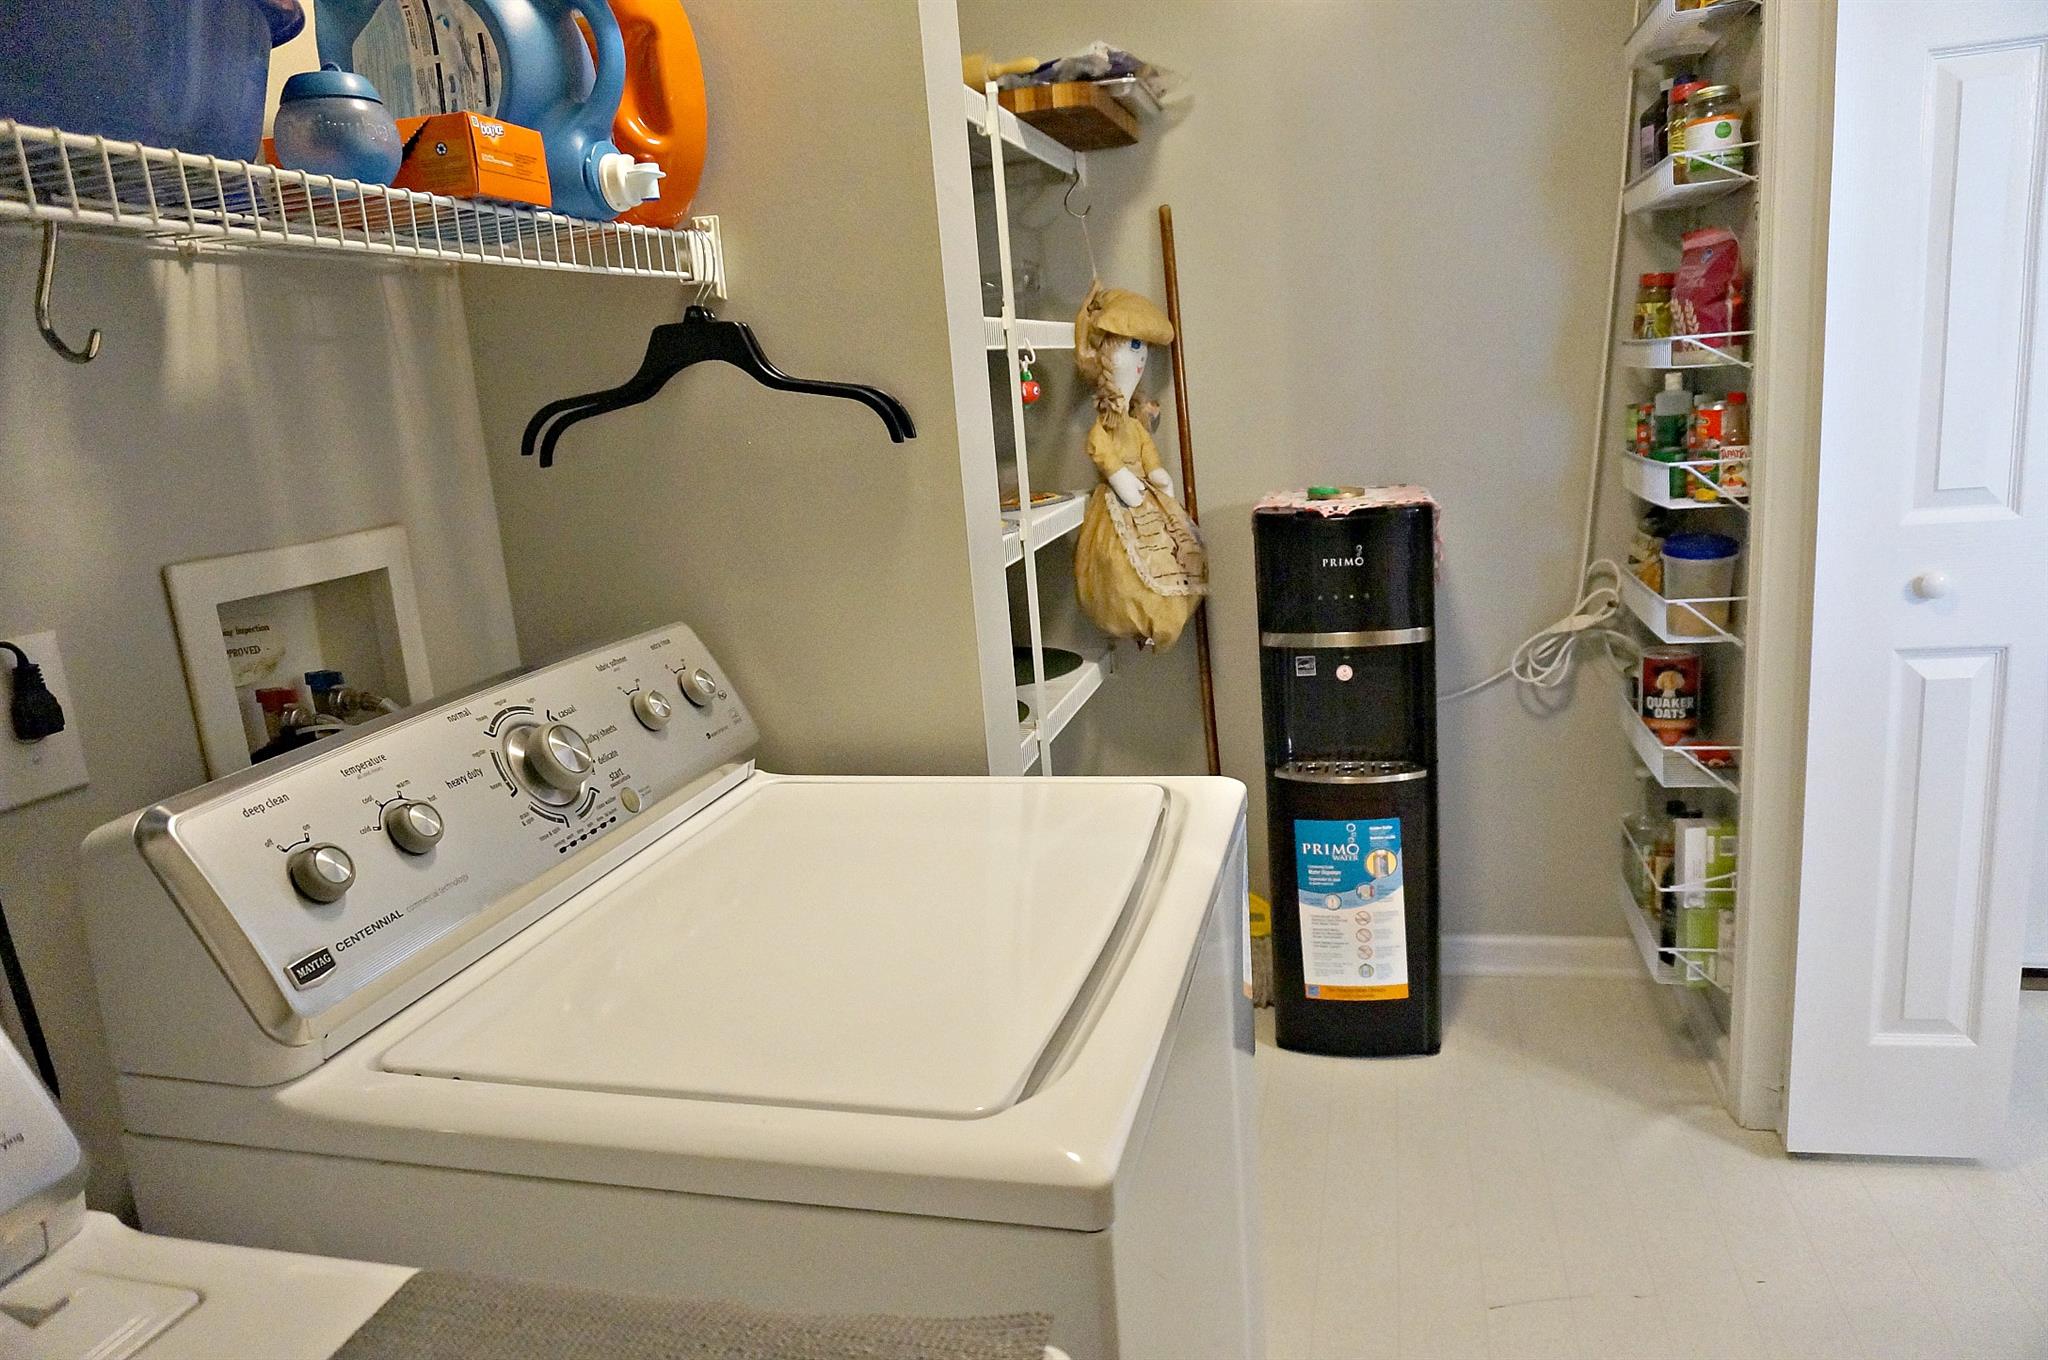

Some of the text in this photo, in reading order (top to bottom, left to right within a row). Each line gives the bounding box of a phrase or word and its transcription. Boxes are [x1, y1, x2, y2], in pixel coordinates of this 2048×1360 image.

[1322, 557, 1364, 567] PRIMO
[1646, 696, 1695, 710] QUAKER
[446, 708, 472, 723] normal
[558, 704, 577, 719] casual
[1654, 708, 1687, 719] OATS
[340, 753, 387, 777] temperature
[598, 750, 619, 765] delicate
[445, 768, 484, 790] heavy duty
[608, 768, 624, 781] start
[242, 793, 290, 818] deep clean
[360, 825, 372, 835] cold
[1302, 843, 1360, 855] PRIMO
[335, 909, 405, 952] CENTENNIAL
[296, 953, 332, 978] MAYTAG
